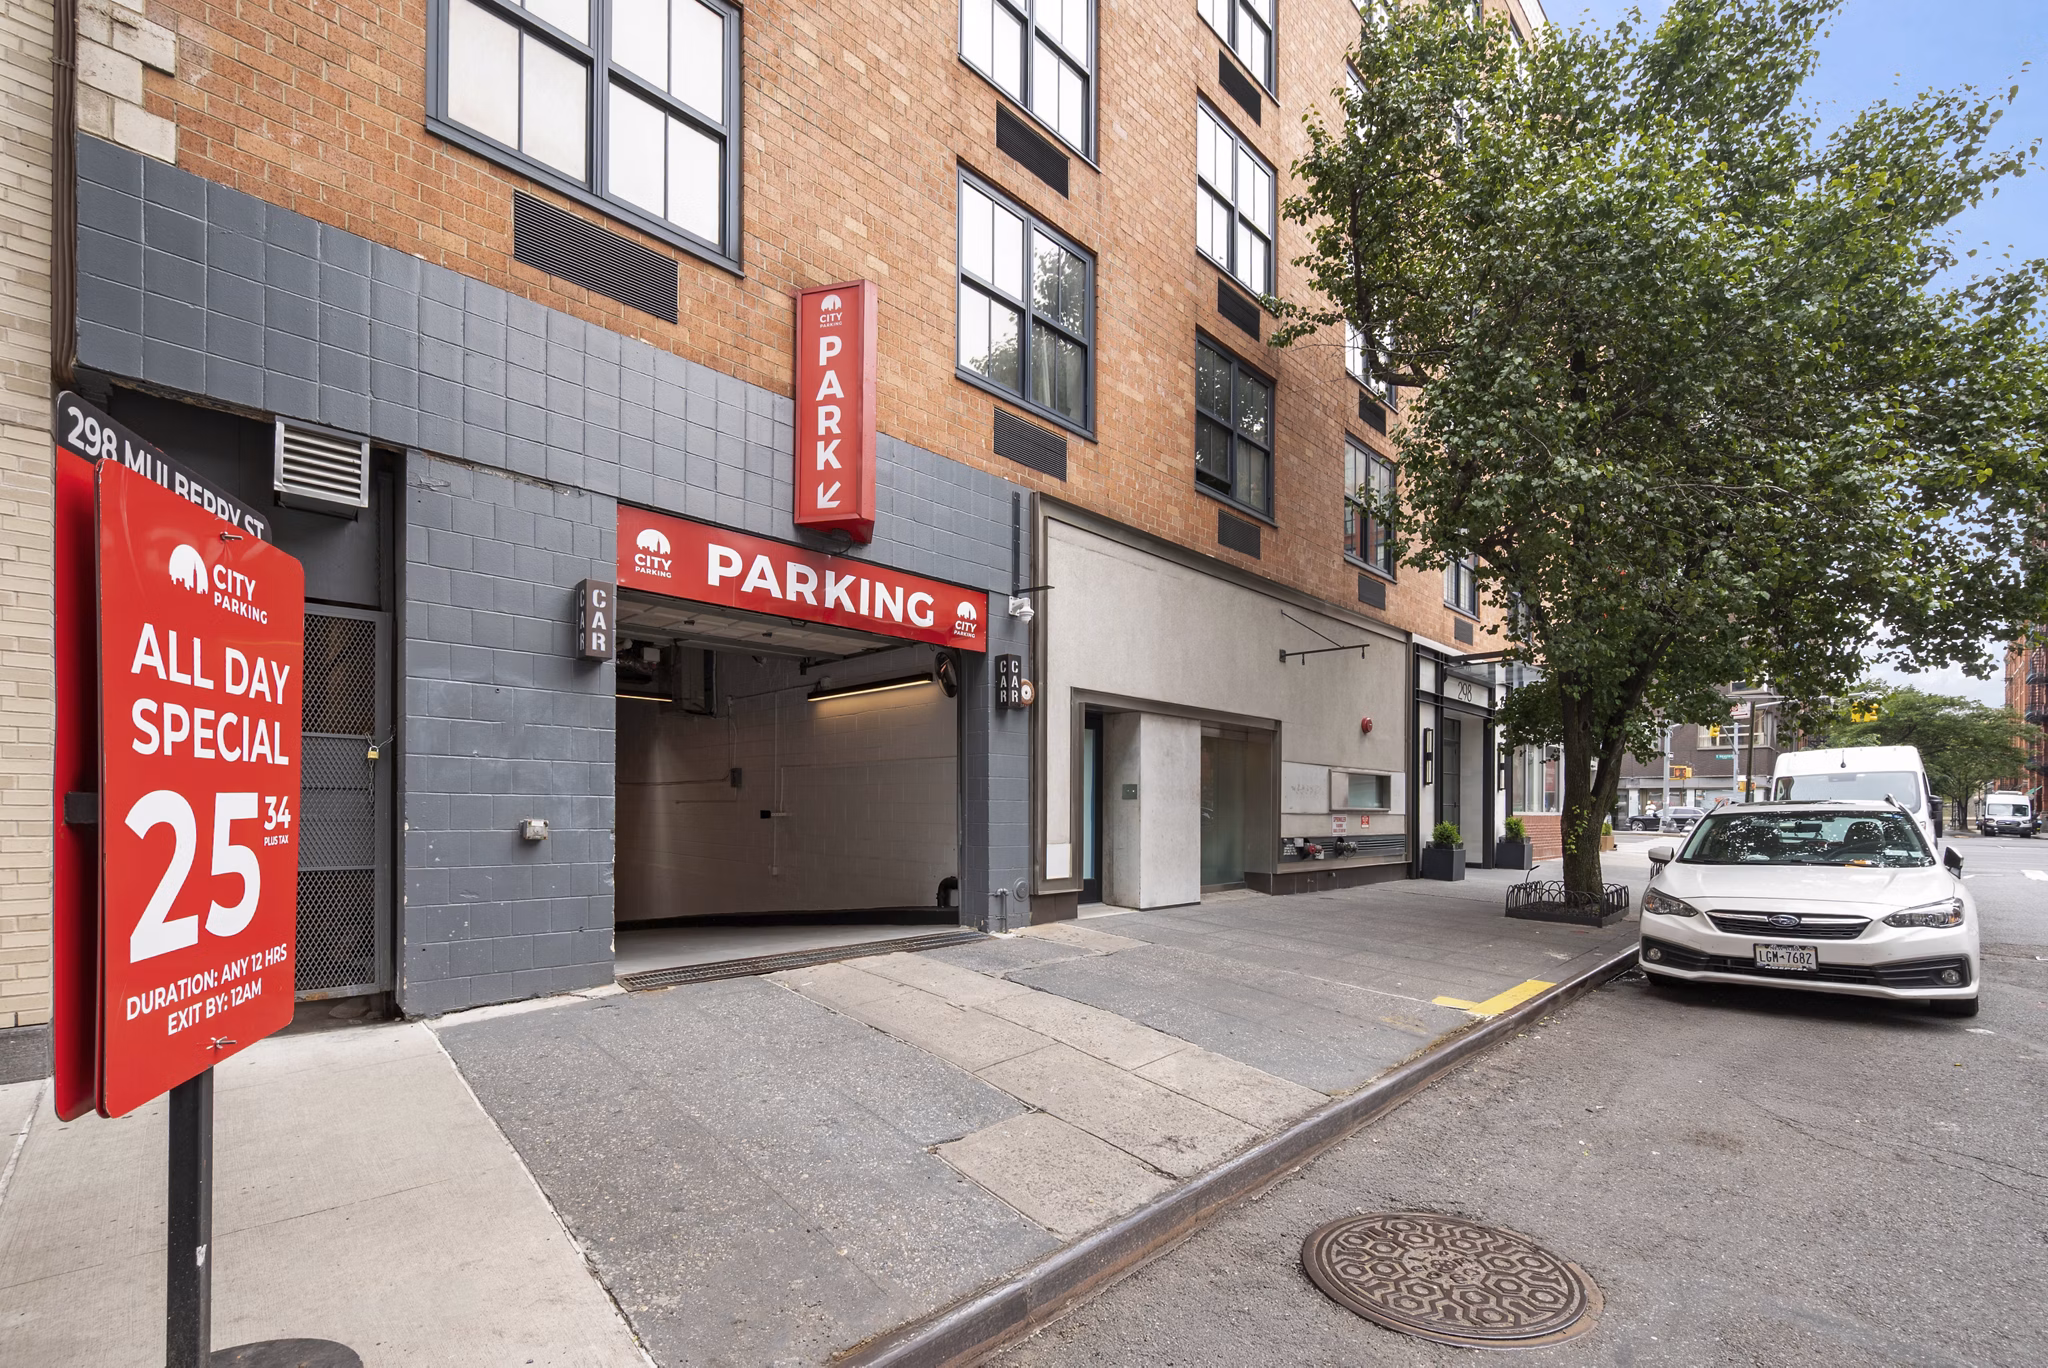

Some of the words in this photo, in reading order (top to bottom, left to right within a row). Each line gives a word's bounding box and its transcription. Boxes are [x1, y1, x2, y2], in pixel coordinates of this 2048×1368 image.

[820, 312, 843, 323] CITY
[820, 321, 843, 329] PARKING
[815, 335, 845, 471] PARK
[67, 405, 118, 462] 298
[244, 514, 265, 540] ST
[213, 563, 256, 602] CITY
[634, 553, 672, 571] CITY
[634, 565, 672, 579] PARKING
[707, 543, 935, 628] PARKING
[213, 593, 268, 625] PARKING
[591, 588, 607, 652] CAR
[955, 620, 977, 633] CITY
[953, 629, 976, 639] PARKING
[131, 622, 214, 691] ALL
[225, 647, 291, 705] DAY
[1011, 660, 1019, 703] CAR
[1457, 681, 1473, 703] 298
[131, 698, 290, 766] SPECIAL
[263, 835, 279, 847] PLUS
[278, 833, 289, 845] TAX
[124, 789, 262, 964] 25
[263, 795, 292, 831] 34
[126, 968, 219, 1021] DURATION:
[220, 956, 250, 986] ANY
[250, 950, 264, 974] 12
[265, 942, 288, 970] HRS
[167, 1004, 201, 1036] EXIT
[205, 996, 229, 1020] BY:
[230, 977, 263, 1006] 12AM
